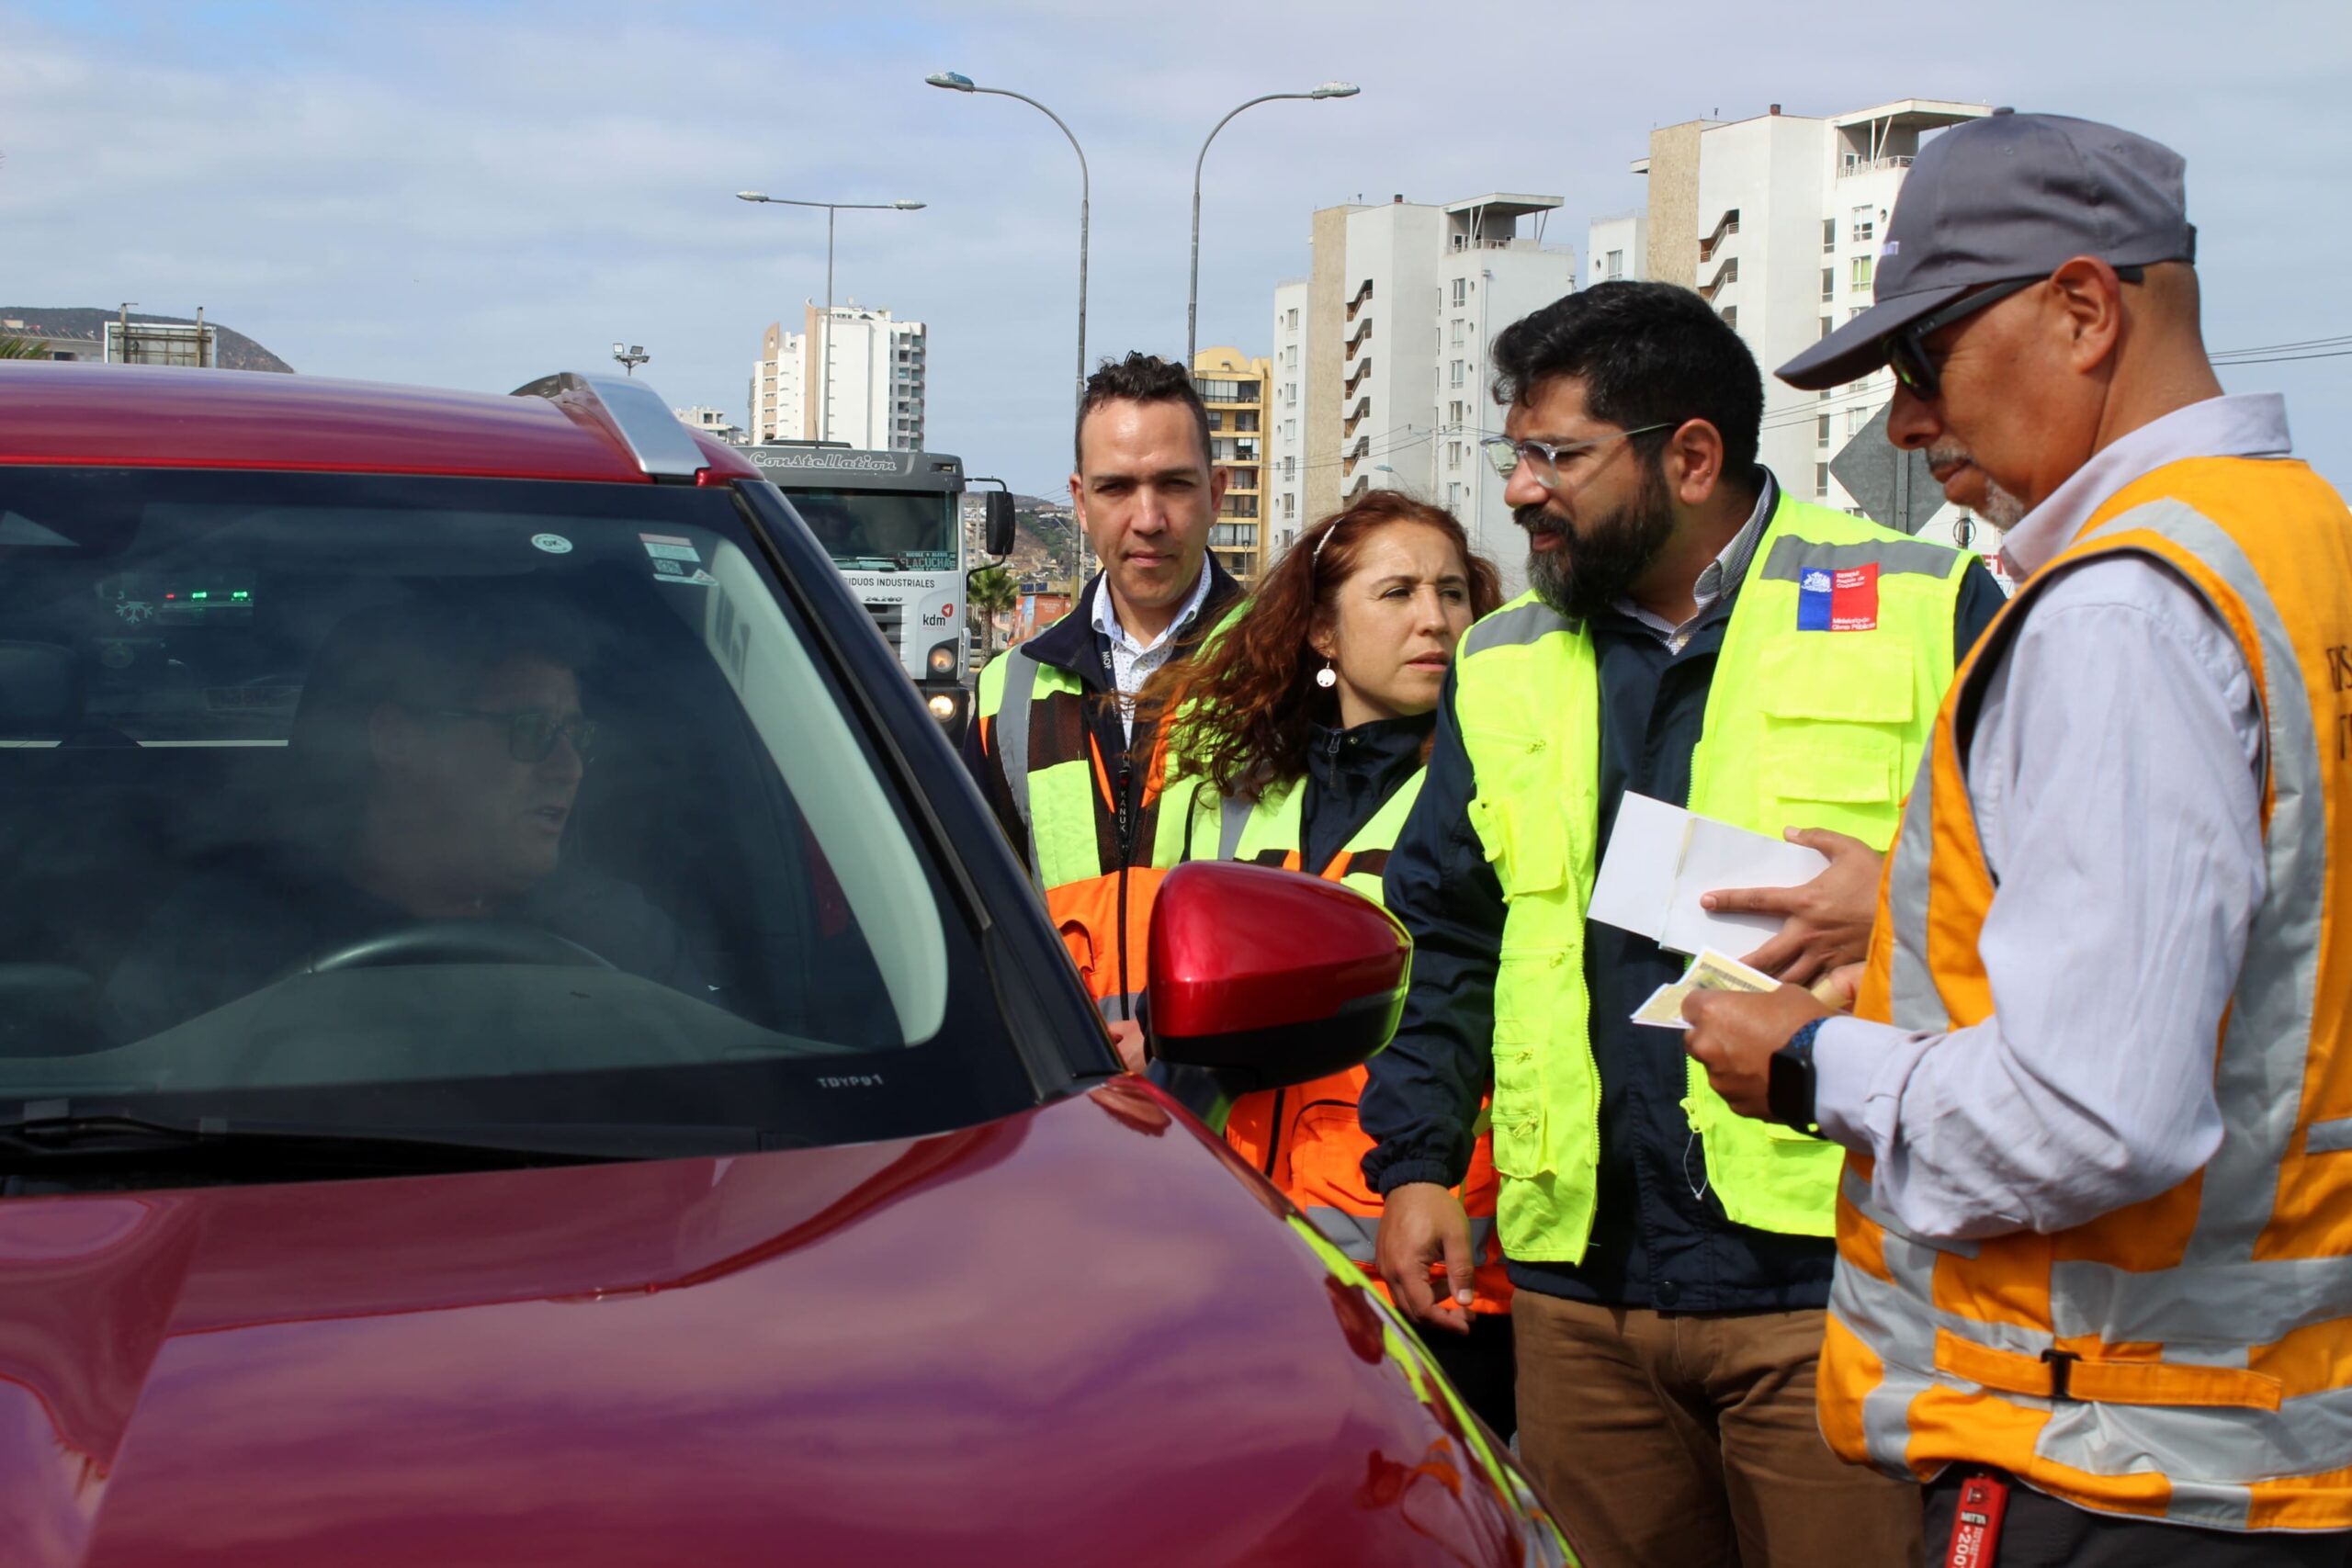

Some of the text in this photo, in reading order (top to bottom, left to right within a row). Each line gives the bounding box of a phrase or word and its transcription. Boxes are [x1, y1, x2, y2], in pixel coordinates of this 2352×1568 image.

[750, 451, 897, 471] Constellation
[876, 578, 935, 588] INDUSTRIALES
[922, 614, 946, 626] kdm
[1102, 650, 1112, 670] MOP
